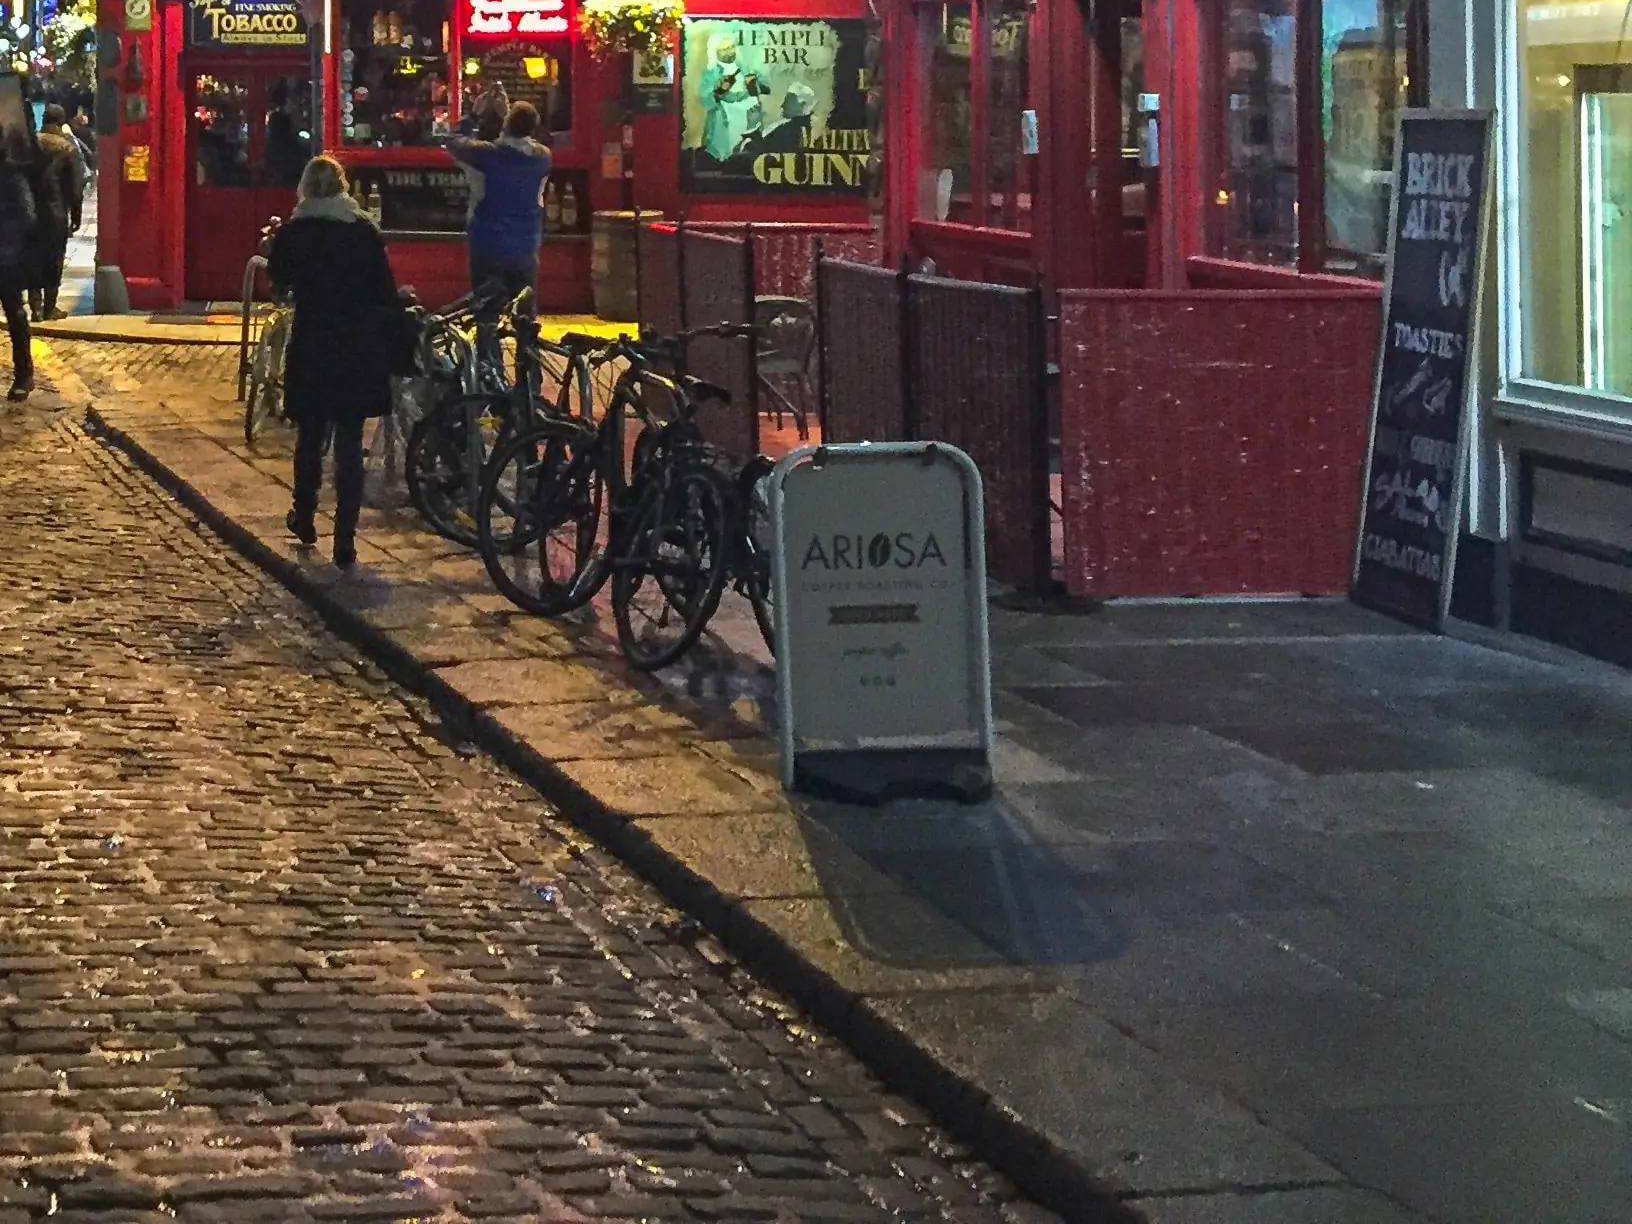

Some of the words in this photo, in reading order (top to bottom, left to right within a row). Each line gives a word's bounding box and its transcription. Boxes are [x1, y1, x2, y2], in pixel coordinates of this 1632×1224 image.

[203, 7, 297, 39] TOBACCO
[737, 29, 826, 47] TEMPLE
[763, 47, 810, 66] BAR
[800, 126, 871, 152] MALTE
[1404, 151, 1475, 198] BRICK
[801, 531, 948, 570] ARIOSA
